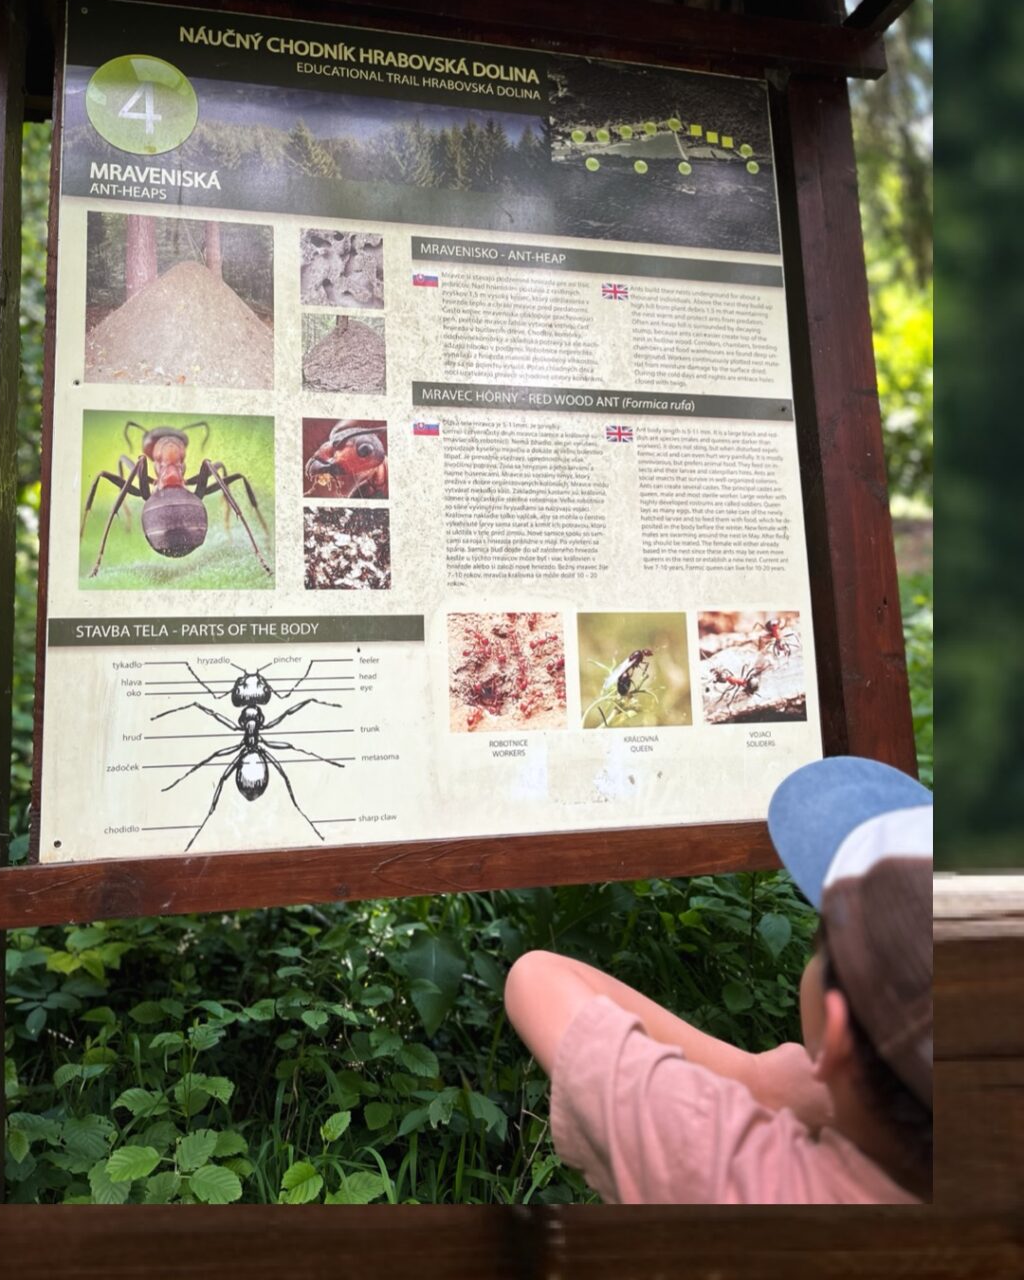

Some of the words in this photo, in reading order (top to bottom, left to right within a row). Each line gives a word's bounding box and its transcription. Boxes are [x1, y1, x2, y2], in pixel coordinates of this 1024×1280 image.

[179, 26, 263, 51] NÁUČNÝ
[266, 37, 356, 62] CHODNÍK
[360, 48, 469, 76] HRABOVSKÁ
[473, 62, 540, 84] DOLINA
[297, 62, 384, 82] EDUCATIONAL
[386, 73, 420, 87] TRAIL
[422, 77, 494, 95] HRABOVSKÁ
[497, 86, 541, 101] DOLINA
[118, 81, 162, 135] 4
[90, 162, 221, 190] MRAVENISKÁ
[90, 183, 167, 200] ANT-HEAPS
[421, 243, 498, 259] MRAVENISKO
[508, 252, 567, 264] ANT-HEAP
[422, 388, 473, 402] MRAVEC
[529, 393, 552, 405] RED
[554, 395, 593, 407] WOOD
[596, 397, 620, 408] ANT
[622, 397, 668, 410] (Formica
[670, 400, 695, 412] rufa)
[76, 624, 130, 638] STAVBA
[133, 624, 168, 637] TELA
[181, 624, 225, 637] PARTS
[228, 623, 248, 636] OF
[250, 623, 276, 635] THE
[280, 623, 319, 635] BODY
[196, 656, 230, 666] hryzadlo
[273, 655, 302, 665] pincher
[359, 656, 380, 665] feeler
[112, 661, 143, 671] tykadlo
[359, 672, 377, 681] head
[121, 678, 142, 687] hlava
[126, 689, 142, 697] oko
[360, 685, 373, 693] eye
[360, 725, 380, 733] trunk
[749, 731, 772, 739] VOJACI
[489, 739, 528, 748] ROBOTNICE
[492, 749, 526, 758] WORKERS
[630, 745, 654, 753] QUEEN
[361, 753, 400, 761] metasoma
[106, 763, 140, 772] zadoček
[358, 814, 378, 823] sharp
[380, 814, 397, 822] claw
[104, 825, 140, 834] chodidlo
